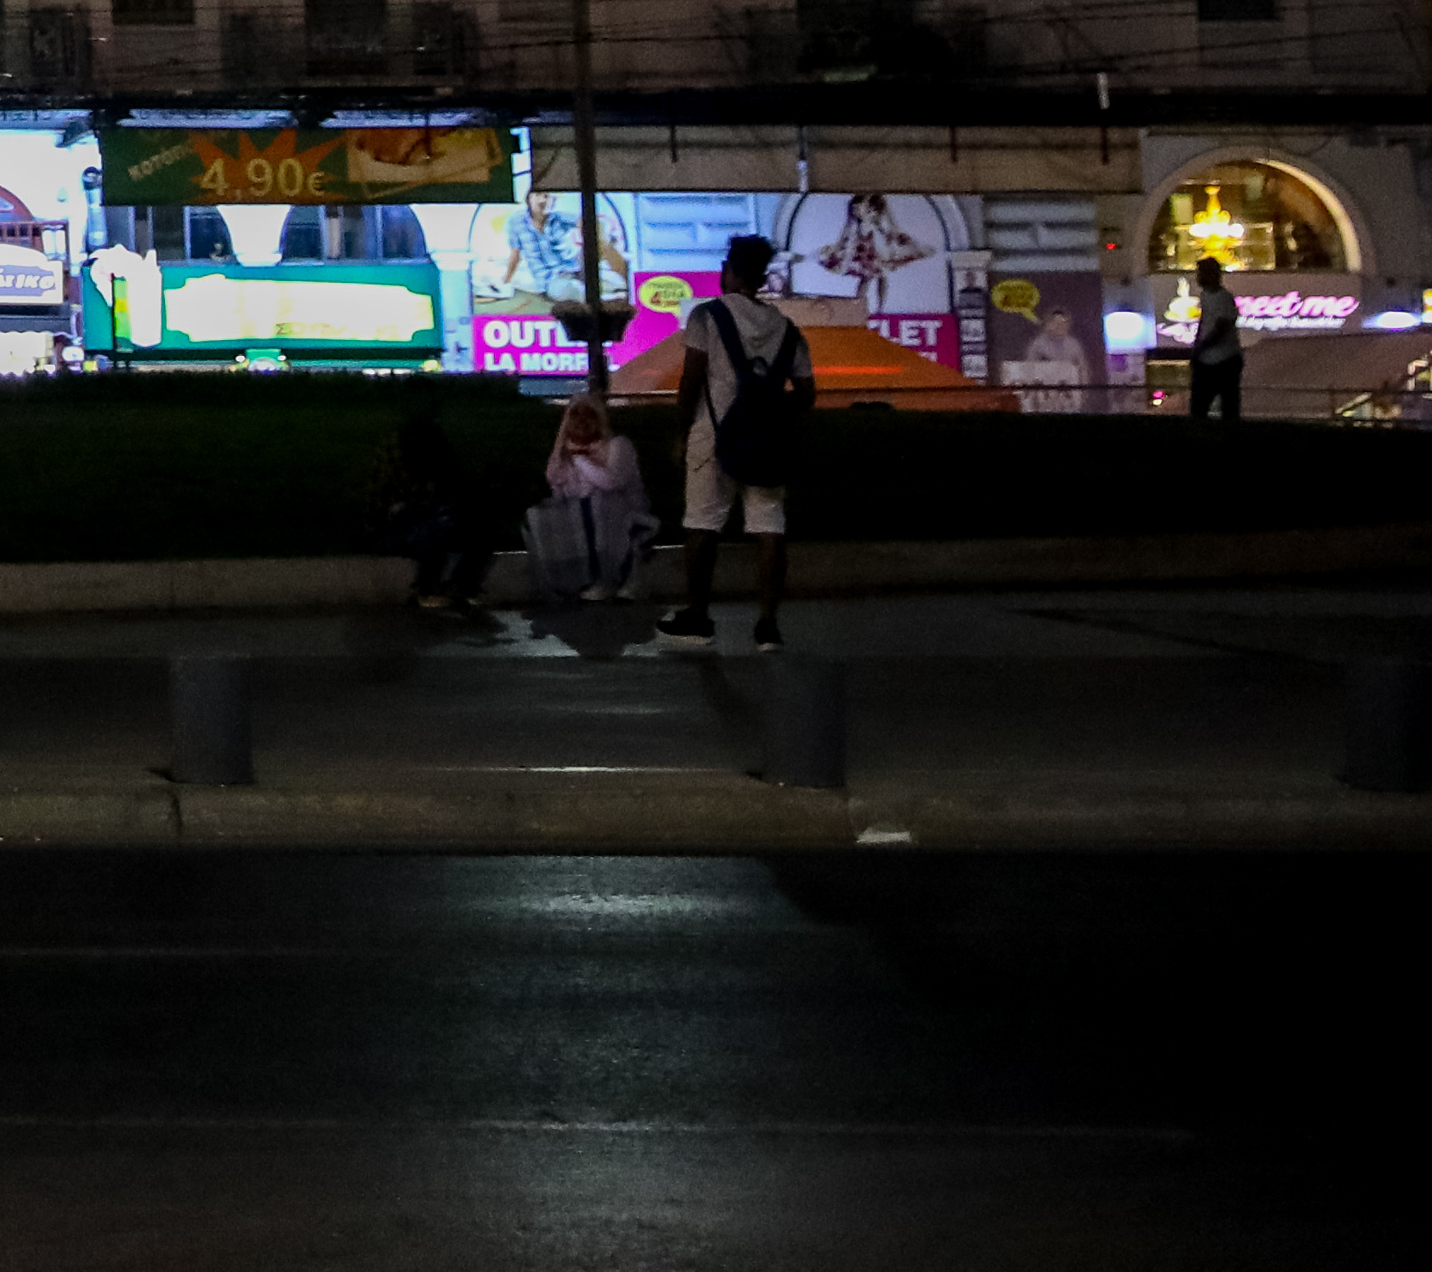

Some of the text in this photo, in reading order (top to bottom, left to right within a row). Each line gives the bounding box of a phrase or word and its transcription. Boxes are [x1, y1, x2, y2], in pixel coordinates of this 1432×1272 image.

[199, 158, 326, 200] 4,90€
[1299, 296, 1360, 318] me
[483, 319, 614, 348] OUTL
[484, 352, 517, 372] LA
